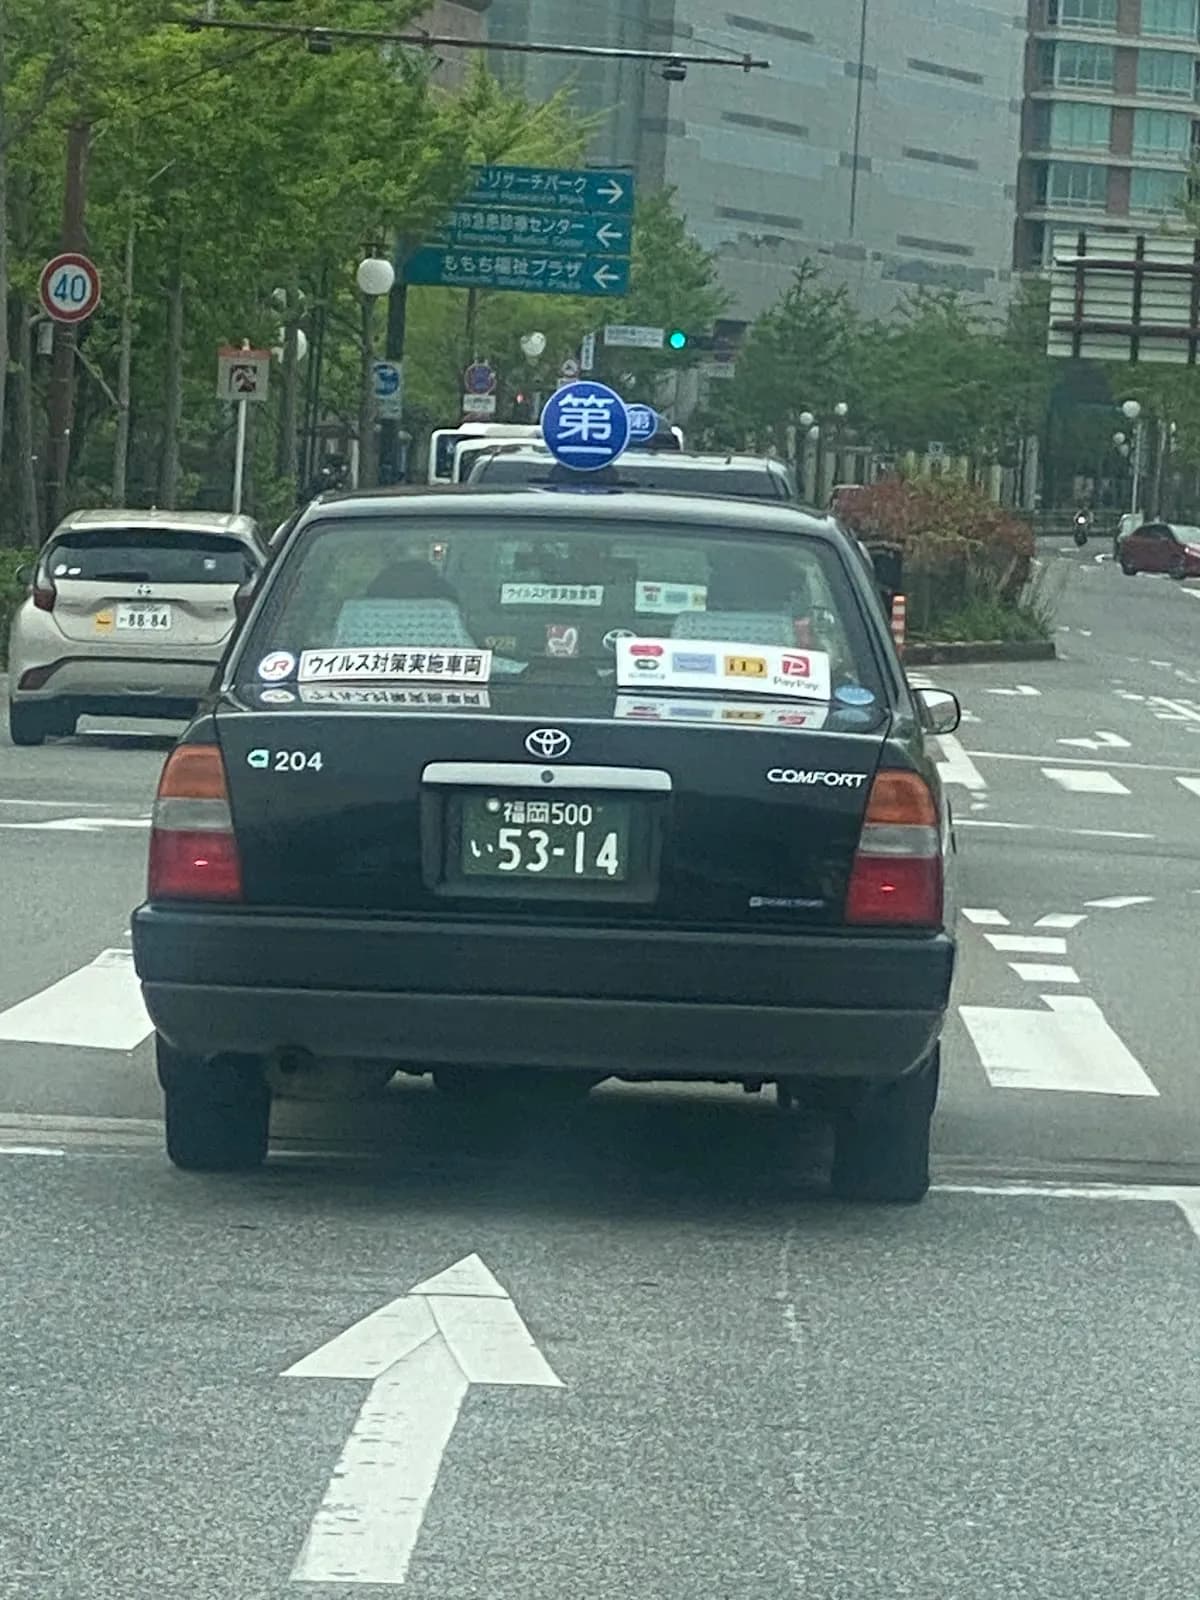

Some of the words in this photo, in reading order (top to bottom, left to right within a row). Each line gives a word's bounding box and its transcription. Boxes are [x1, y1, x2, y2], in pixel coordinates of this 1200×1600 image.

[54, 274, 87, 302] 40
[556, 393, 615, 455] 第一
[308, 652, 483, 677] ウイルス対策実施車両
[772, 676, 819, 692] PayPay
[274, 751, 323, 772] 204
[767, 768, 867, 788] COMFORT
